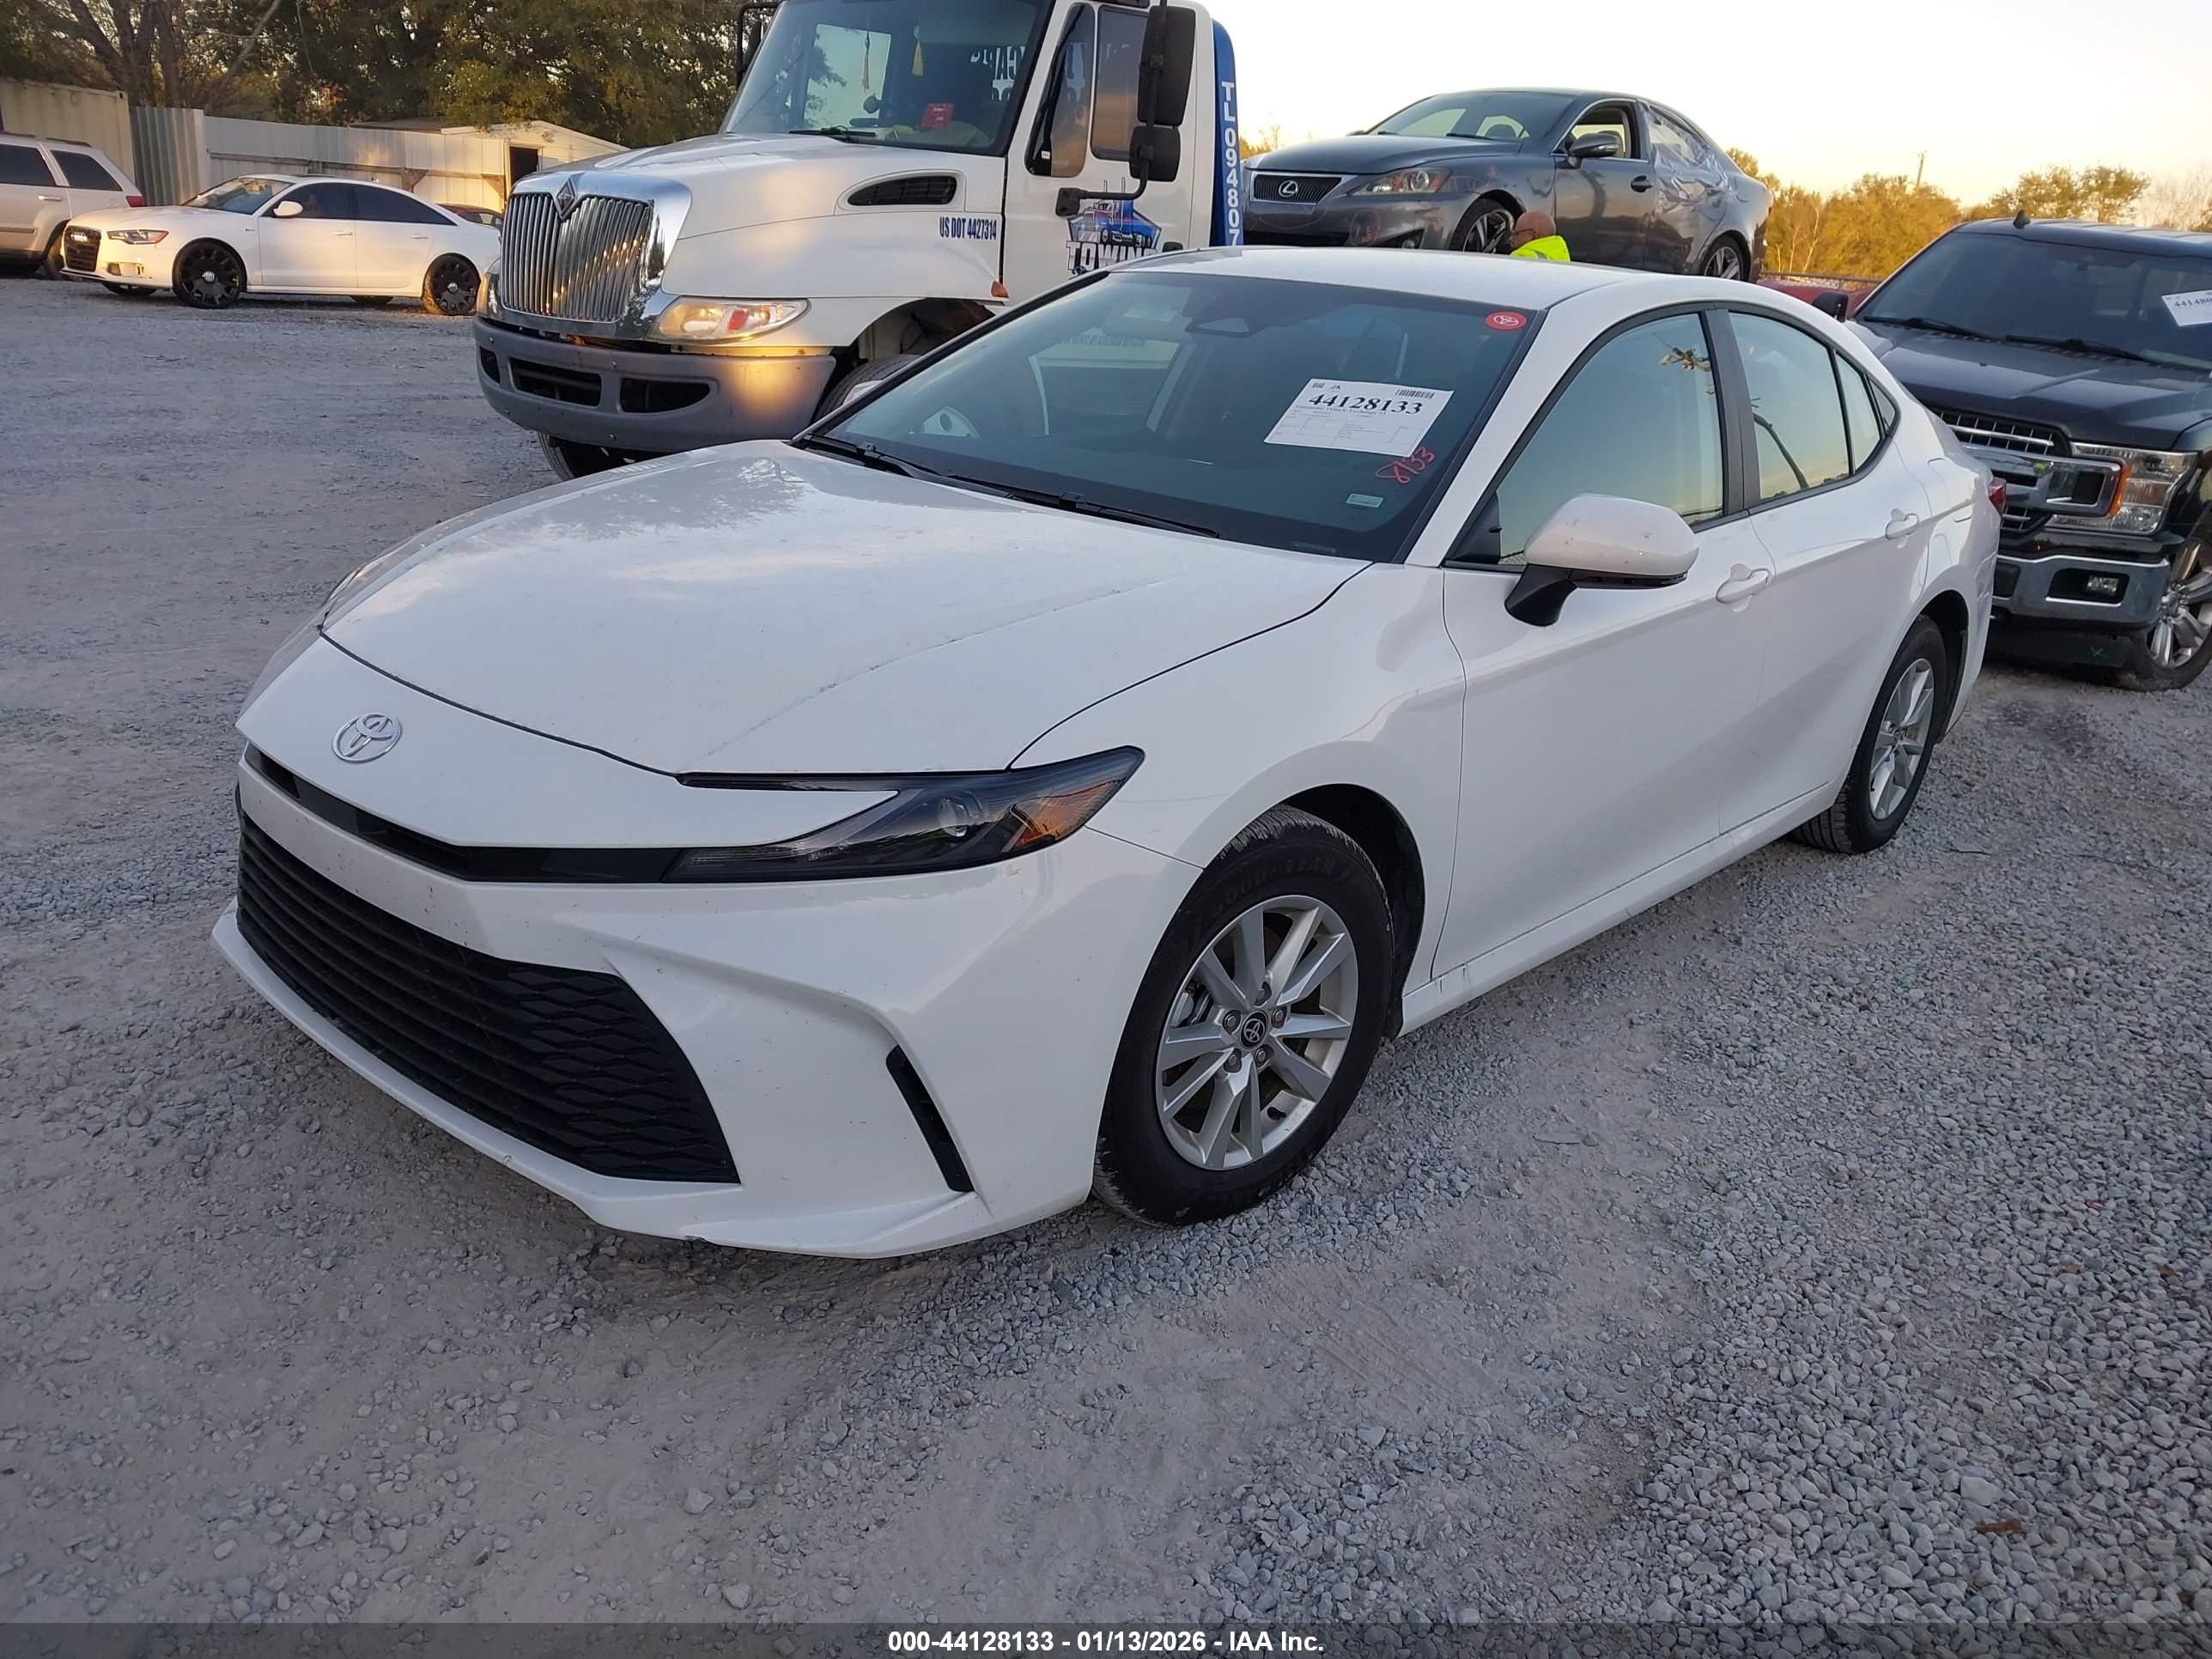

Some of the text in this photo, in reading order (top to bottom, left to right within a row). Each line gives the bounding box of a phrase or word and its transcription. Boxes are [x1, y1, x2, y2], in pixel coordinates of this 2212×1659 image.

[939, 216, 997, 240] US DOT 4427314
[1308, 393, 1423, 416] 44128133
